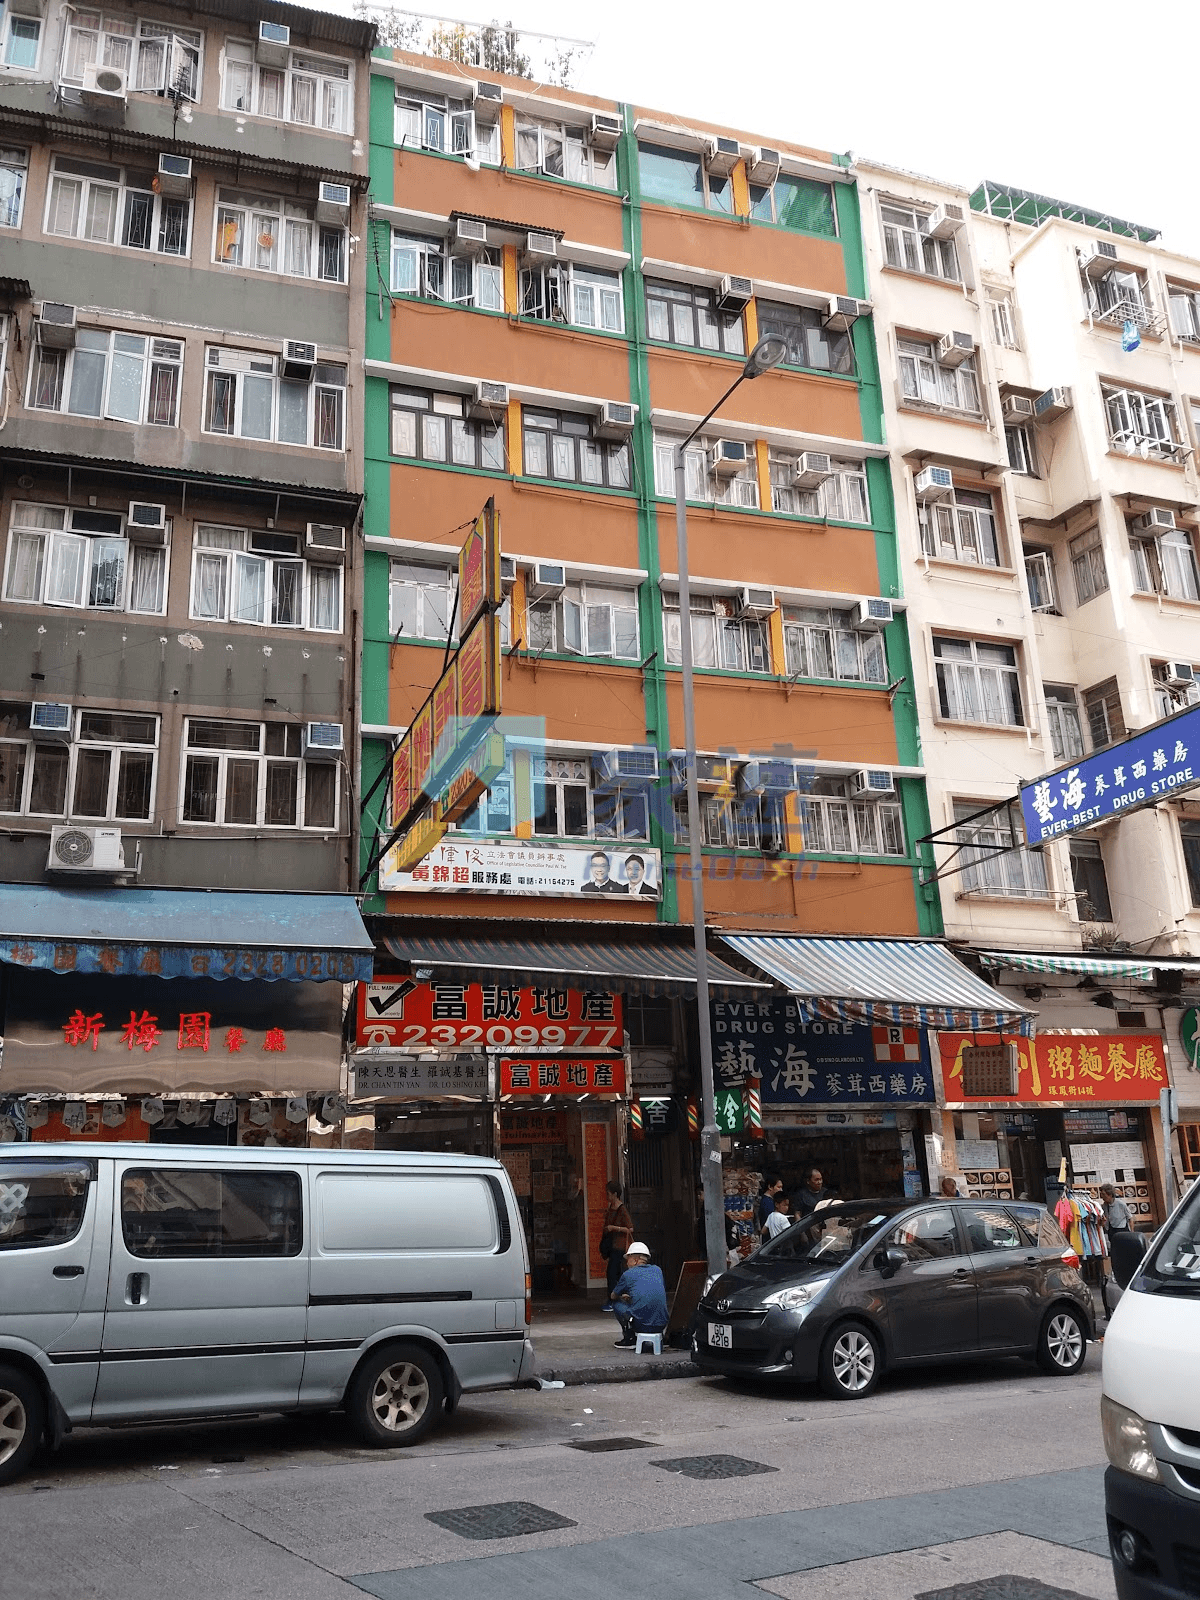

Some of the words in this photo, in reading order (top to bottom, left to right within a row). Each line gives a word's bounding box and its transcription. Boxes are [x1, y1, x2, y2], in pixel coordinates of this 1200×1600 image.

[1040, 805, 1100, 838] EVER-BEST
[1113, 787, 1146, 809] DRUG
[1151, 767, 1194, 794] STORE
[424, 845, 485, 868] 偉俊
[223, 953, 286, 974] 2328
[430, 981, 616, 1021] 富誠地產
[715, 1003, 797, 1018] EVER-B
[402, 1025, 618, 1047] 23209977
[716, 1020, 775, 1034] DRUG
[785, 1022, 854, 1035] STORE
[358, 1066, 421, 1079] 陳天恩醫生
[427, 1066, 488, 1079] 羅誠基醫生
[508, 1063, 613, 1088] 富誠地產
[358, 1081, 369, 1089] DR.
[371, 1081, 391, 1089] CHAN
[393, 1081, 406, 1089] TIN
[406, 1081, 420, 1089] YAN
[441, 1081, 451, 1089] LO
[452, 1081, 473, 1089] SHING
[714, 1324, 725, 1336] GD
[711, 1334, 729, 1347] 4218
